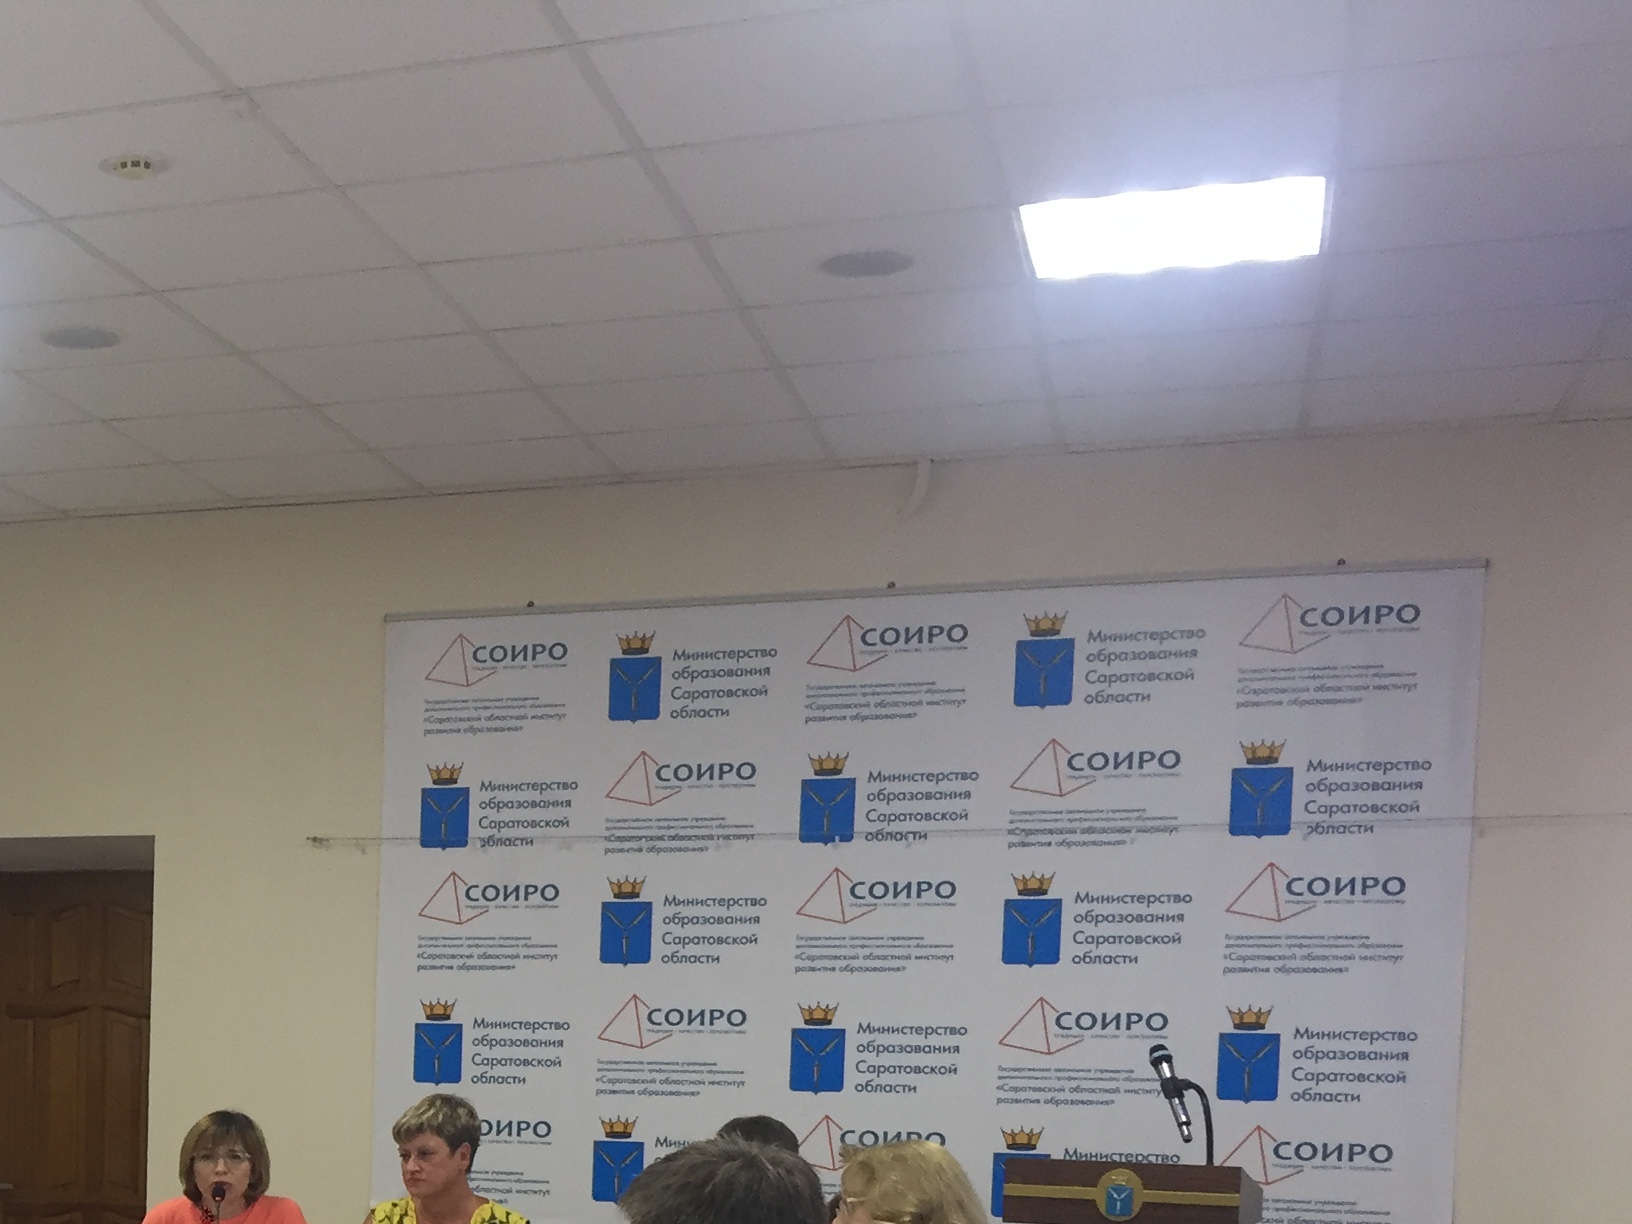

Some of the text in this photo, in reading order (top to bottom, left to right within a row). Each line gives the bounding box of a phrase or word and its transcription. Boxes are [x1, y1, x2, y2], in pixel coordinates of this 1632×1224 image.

[1300, 604, 1421, 627] СОИРО
[860, 625, 968, 646] СОИРО
[1087, 629, 1206, 645] Министерство
[472, 642, 568, 663] СОИРО
[673, 649, 777, 663] Министерство
[1086, 648, 1198, 666] образования
[672, 666, 771, 683] образования
[1085, 668, 1194, 688] Саратовской
[671, 685, 768, 703] Саратовской
[1084, 689, 1150, 704] области
[670, 705, 729, 719] области
[1067, 750, 1180, 771] СОИРО
[1306, 759, 1432, 775] Министерство
[655, 762, 756, 782] СОИРО
[868, 771, 979, 785] Министерство
[480, 780, 578, 795] Министерство
[1305, 777, 1423, 796] образования
[479, 796, 571, 813] образования
[867, 787, 971, 805] образования
[866, 808, 968, 826] Саратовской
[1304, 800, 1420, 819] Саратовской
[479, 816, 569, 833] Саратовской
[865, 828, 927, 842] области
[465, 884, 559, 902] СОИРО
[850, 881, 956, 899] СОИРО
[1286, 876, 1406, 896] СОИРО
[663, 895, 767, 910] Министерство
[1075, 892, 1192, 908] Министерство
[663, 912, 760, 929] образования
[1074, 909, 1184, 927] образования
[662, 932, 758, 949] Саратовской
[1073, 930, 1181, 949] Саратовской
[661, 950, 720, 964] области
[1072, 950, 1138, 964] области
[473, 1018, 570, 1034] Министерство
[647, 1009, 746, 1027] СОИРО
[1055, 1012, 1168, 1031] СОИРО
[857, 1022, 967, 1039] Министерство
[1294, 1027, 1418, 1045] Министерство
[472, 1034, 563, 1050] образования
[856, 1040, 960, 1057] образования
[472, 1053, 561, 1070] Саратовской
[1292, 1045, 1409, 1064] образования
[471, 1071, 526, 1084] области
[856, 1060, 957, 1078] Саратовской
[1292, 1067, 1406, 1086] Саратовской
[855, 1079, 917, 1093] области
[1124, 1087, 1162, 1097] институ
[1291, 1087, 1360, 1103] области
[480, 1120, 552, 1137] ОИРО
[1064, 1148, 1180, 1163] Министерство
[1273, 1142, 1393, 1163] СОИРО
